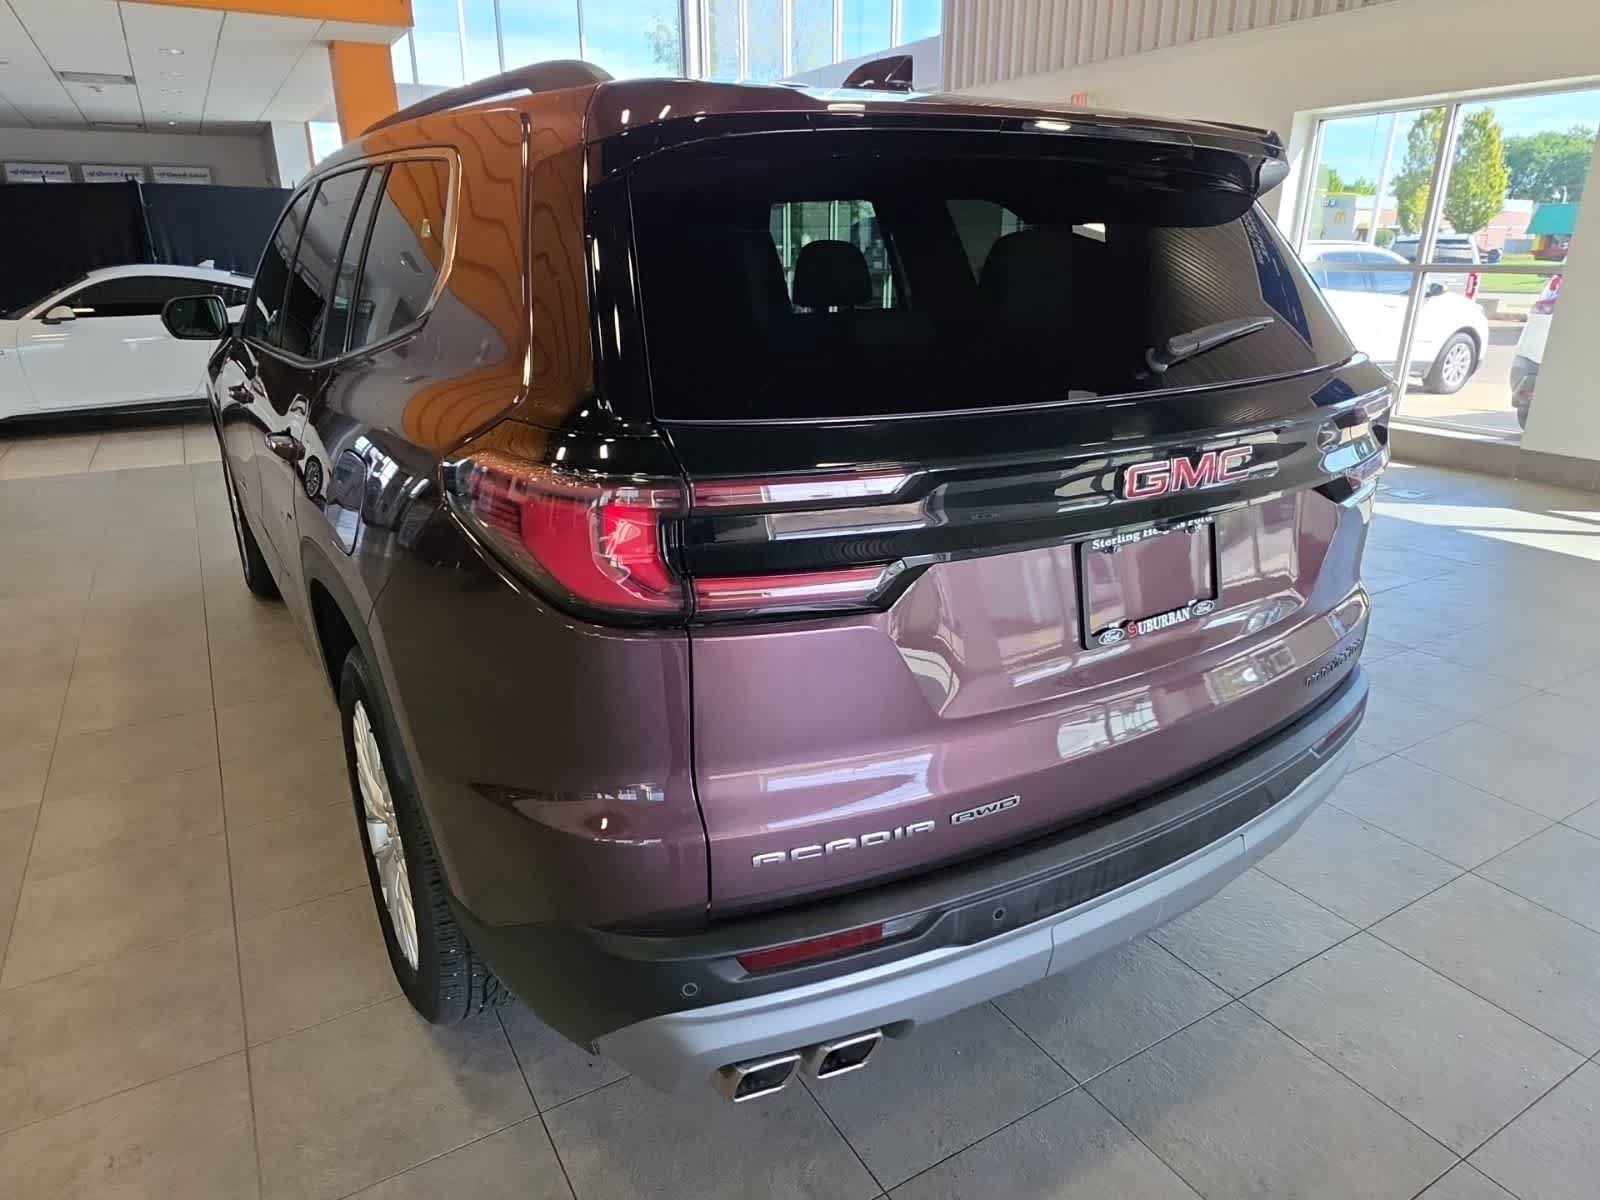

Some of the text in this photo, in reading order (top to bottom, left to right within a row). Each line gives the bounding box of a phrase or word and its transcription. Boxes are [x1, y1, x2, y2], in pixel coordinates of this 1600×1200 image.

[1125, 445, 1253, 499] GMC
[1092, 532, 1141, 550] Sterling
[1127, 607, 1190, 638] SUBURBAN
[752, 796, 1019, 868] ACADIA AWD
